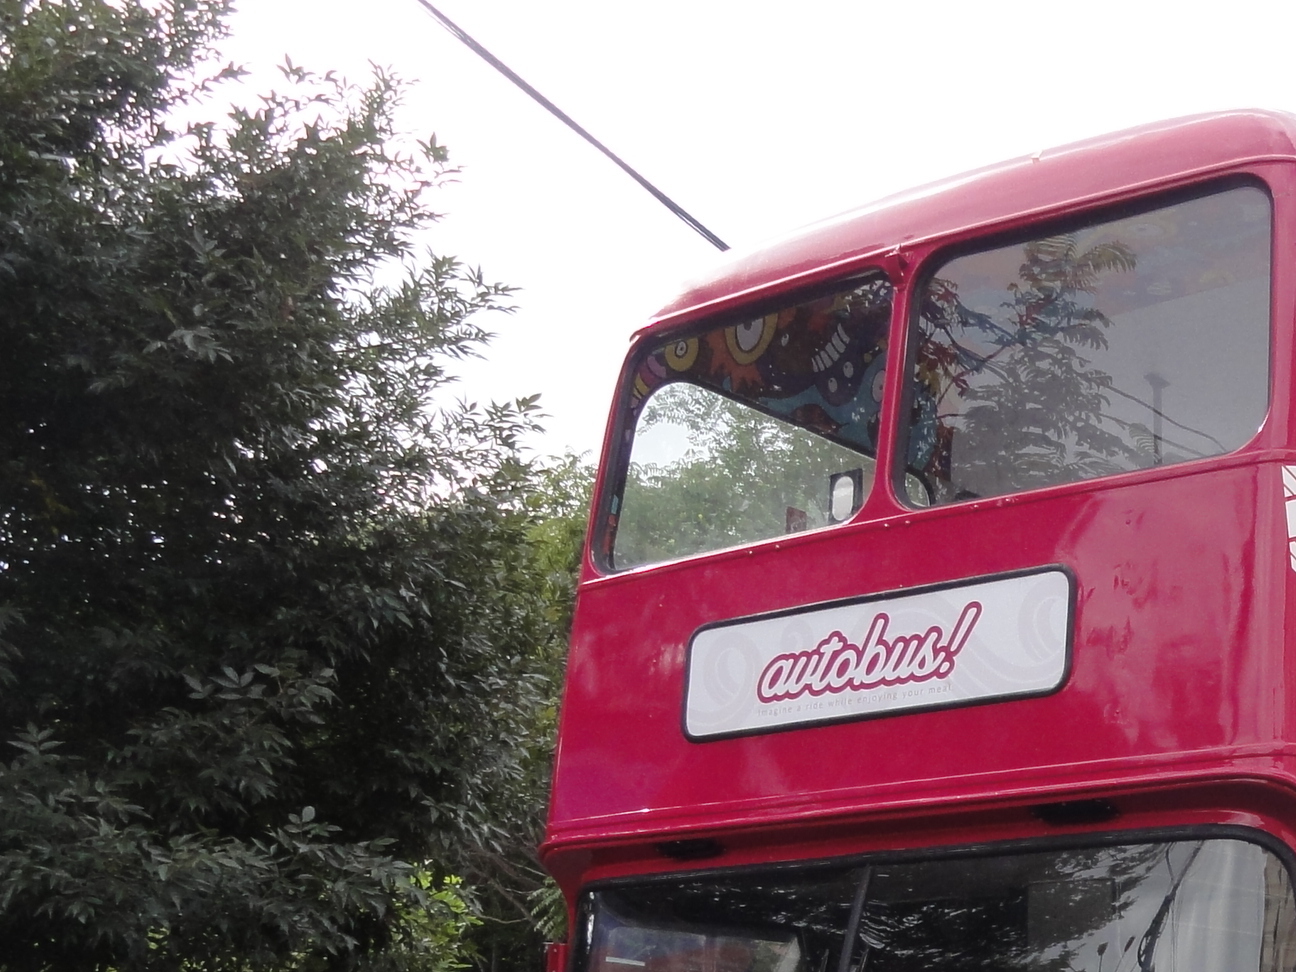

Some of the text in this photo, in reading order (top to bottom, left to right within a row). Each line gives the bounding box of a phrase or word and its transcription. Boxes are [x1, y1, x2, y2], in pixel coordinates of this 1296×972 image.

[805, 701, 824, 710] ride
[827, 697, 853, 707] while
[857, 692, 898, 704] enjoying
[902, 688, 923, 699] your
